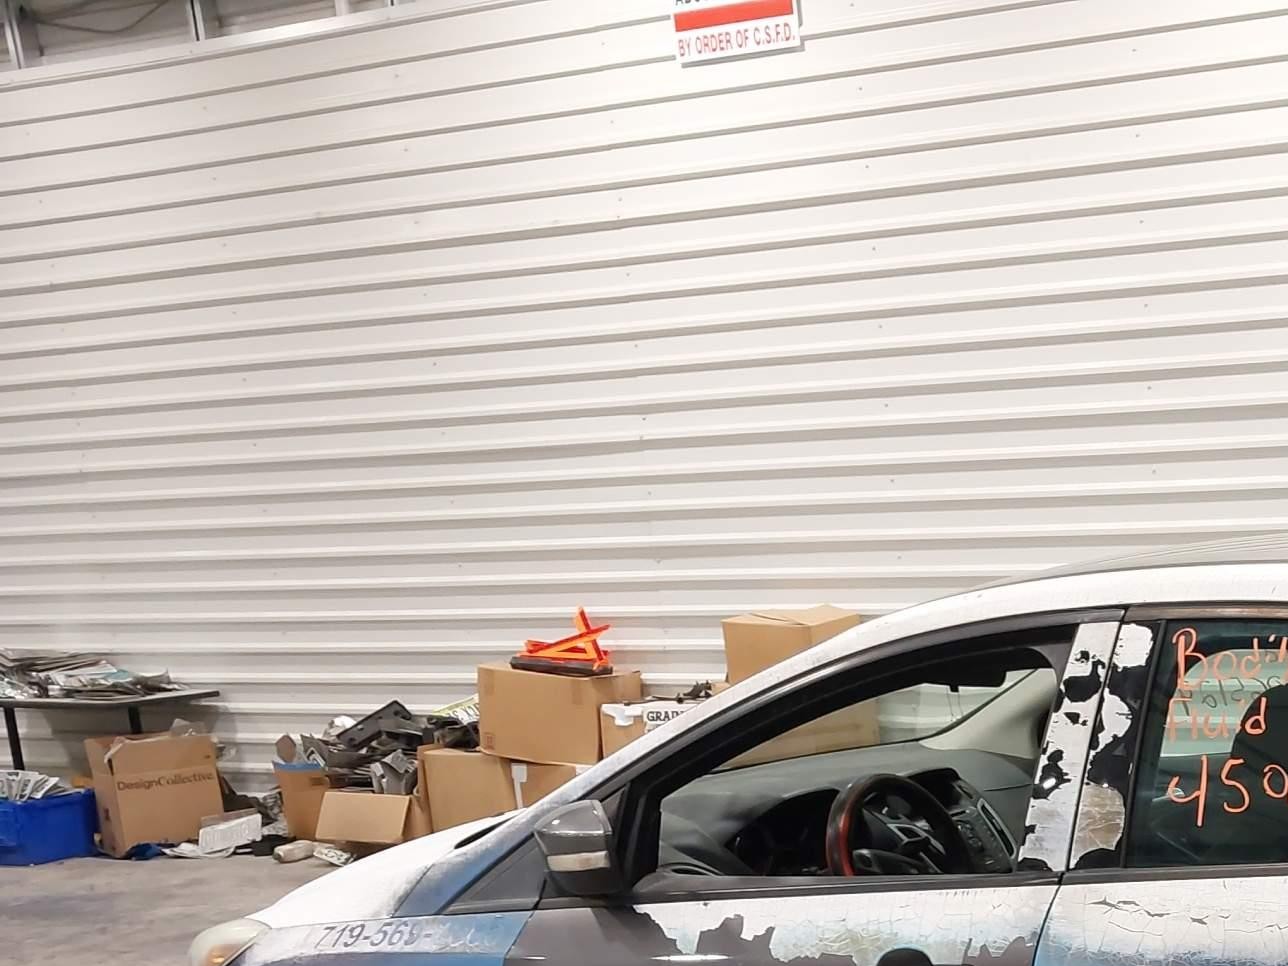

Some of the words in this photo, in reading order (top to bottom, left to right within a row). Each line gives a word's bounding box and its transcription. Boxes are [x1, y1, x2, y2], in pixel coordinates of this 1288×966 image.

[678, 37, 692, 57] BY
[695, 31, 734, 54] ORDER
[735, 28, 750, 49] OF
[753, 22, 796, 46] C.S.F.D.
